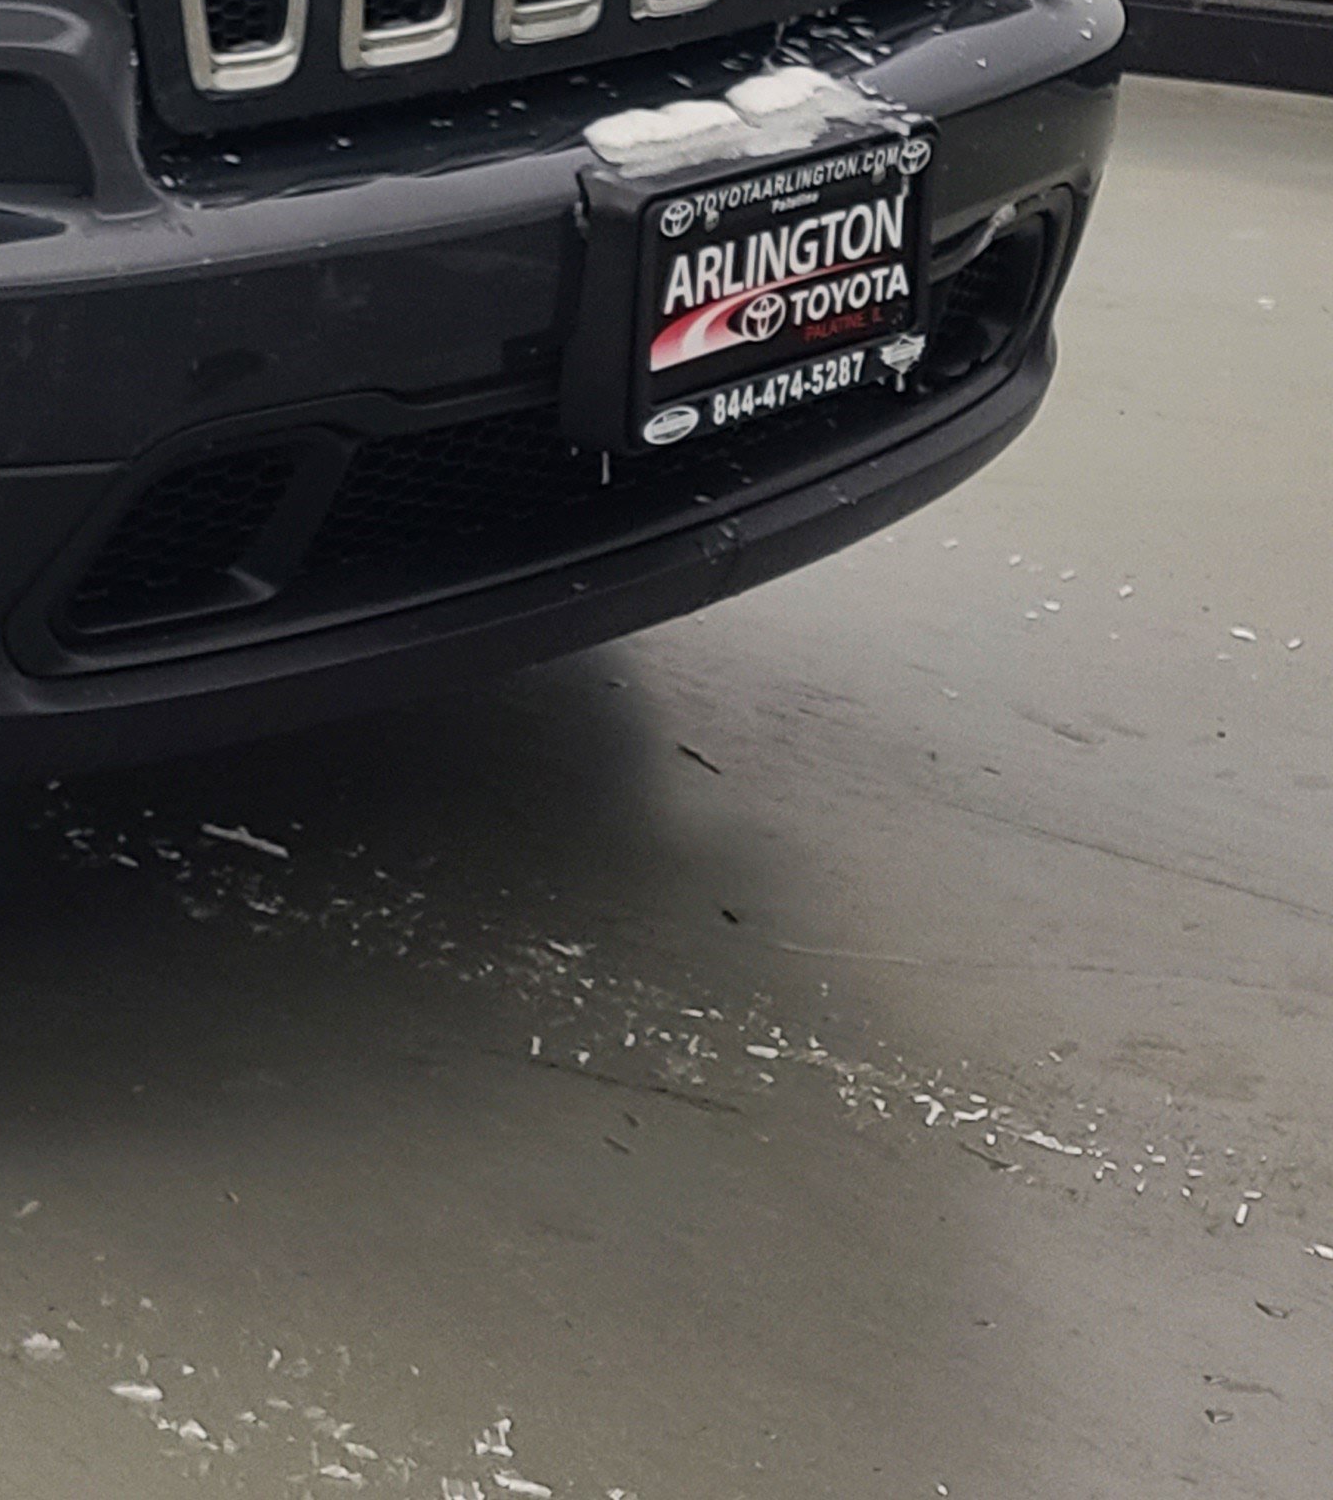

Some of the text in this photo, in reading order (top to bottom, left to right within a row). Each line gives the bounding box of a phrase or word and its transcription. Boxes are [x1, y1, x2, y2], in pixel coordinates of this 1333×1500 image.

[695, 146, 900, 216] TOYOTAARLINGTON.COM
[664, 195, 905, 315] ARLINGTON
[790, 264, 909, 326] TOYOTA
[713, 351, 865, 425] 844-474-5287
